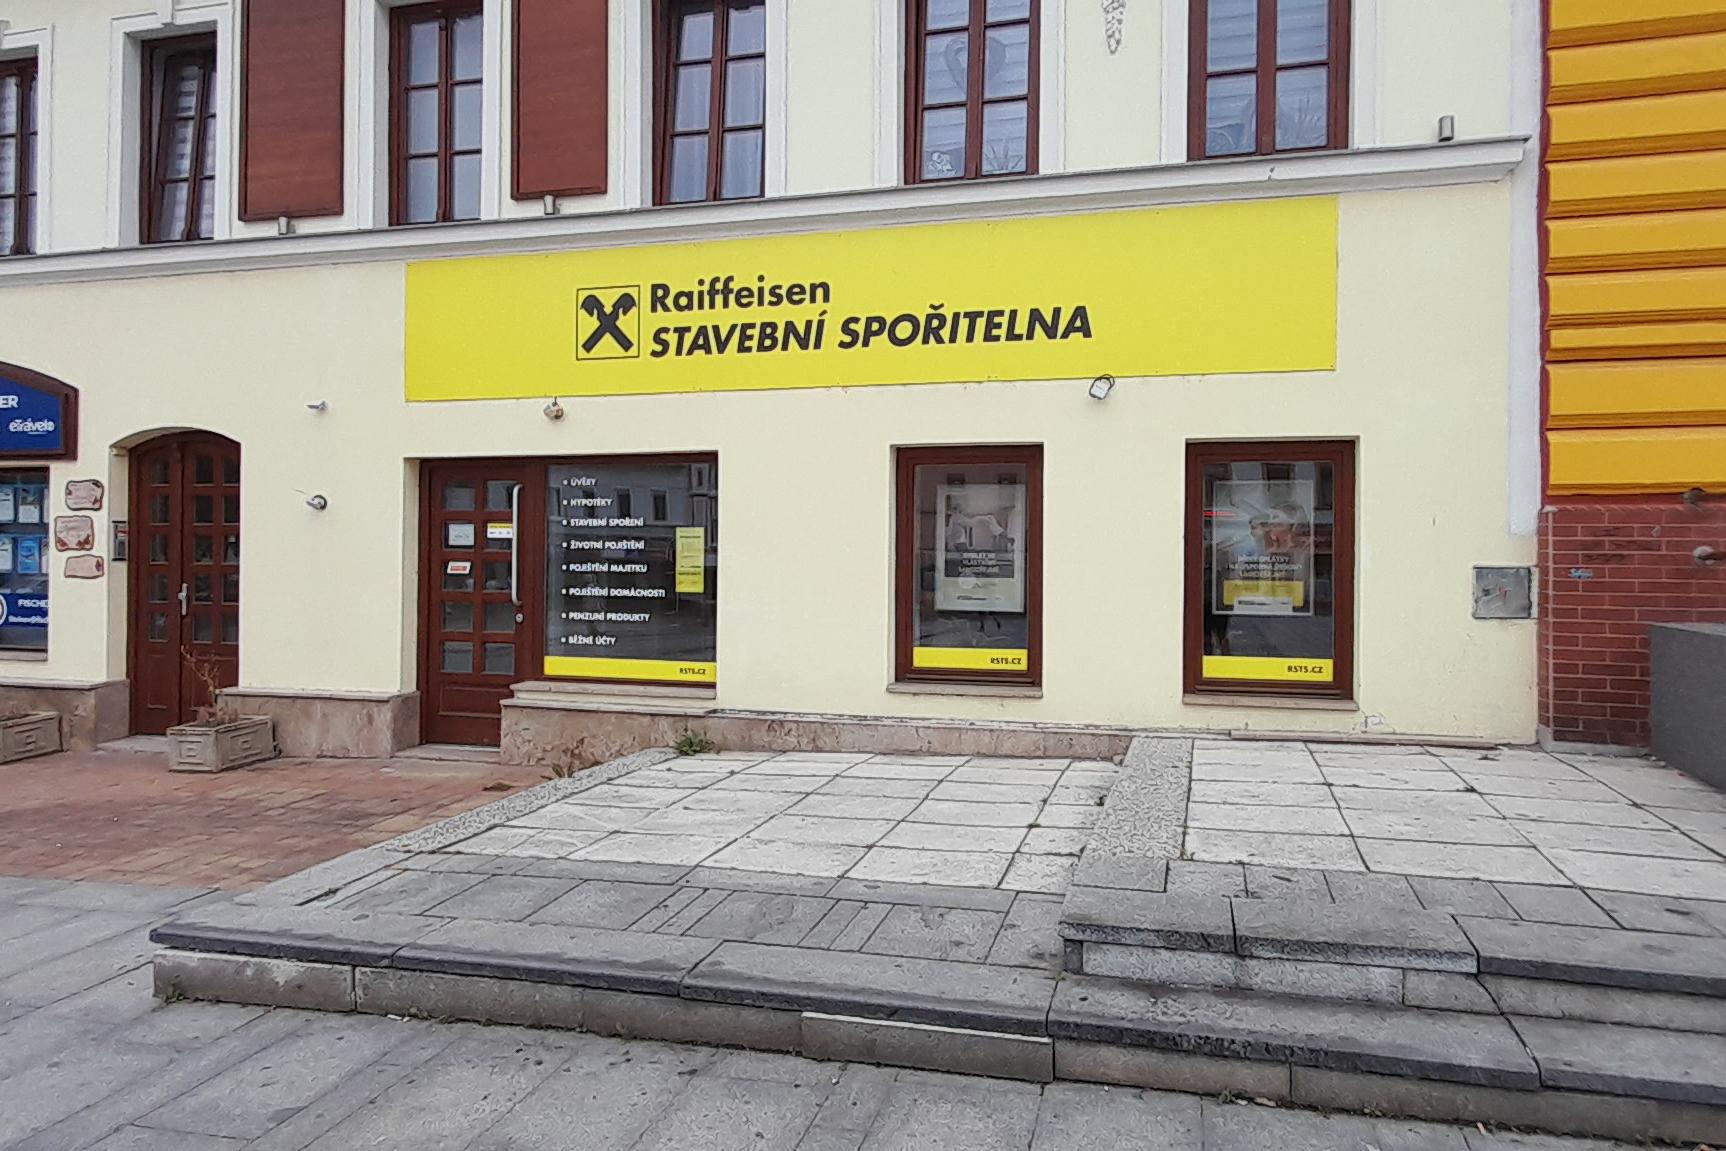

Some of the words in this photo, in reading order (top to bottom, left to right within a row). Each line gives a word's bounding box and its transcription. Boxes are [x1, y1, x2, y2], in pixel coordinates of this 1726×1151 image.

[650, 275, 831, 313] Raiffeisen
[650, 310, 828, 358] STAVEBNÍ
[838, 302, 1092, 349] SPOŘITELNA
[570, 497, 612, 507] HYPOTÉKY
[570, 517, 607, 526] STAVEBNÍ
[609, 516, 644, 526] SPOŘENÍ
[570, 539, 603, 549] ŽIVOTNÍ
[605, 539, 645, 549] POJIŠTĚNÍ
[569, 562, 608, 572] POJIŠTĚNÍ
[610, 564, 648, 572] MAJETKU
[569, 586, 608, 596] POJIŠTĚNÍ
[610, 587, 666, 597] DOMÁCNOSTI
[606, 612, 650, 622] PRODUKTY
[595, 635, 617, 645] ÚČTY
[1287, 665, 1324, 673] RSTS.CZ
